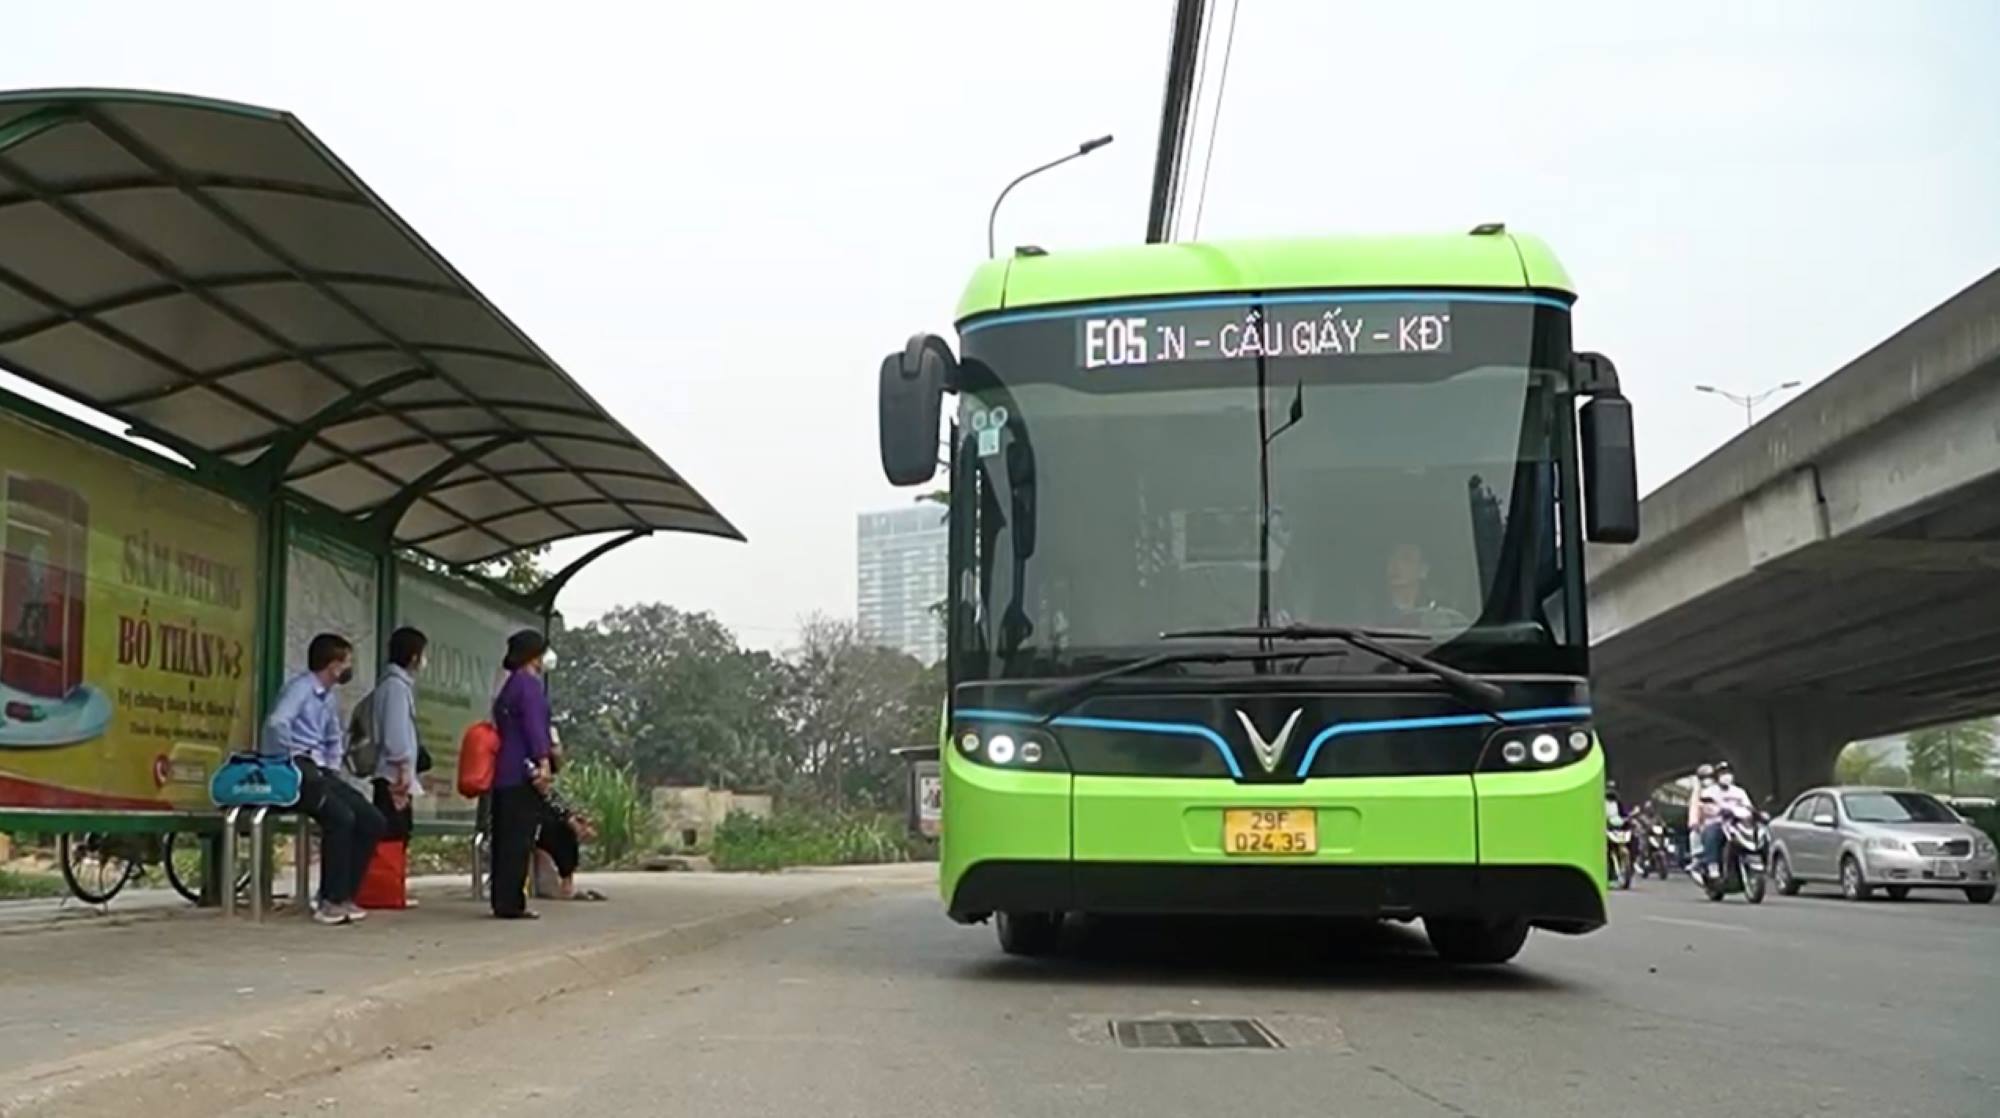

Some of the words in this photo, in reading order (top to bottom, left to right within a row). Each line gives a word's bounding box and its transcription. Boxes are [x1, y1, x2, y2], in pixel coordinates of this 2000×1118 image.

[1085, 318, 1147, 368] E05
[1220, 309, 1283, 358] CẦU
[1292, 307, 1363, 355] GIẤY
[1251, 812, 1289, 831] 29F
